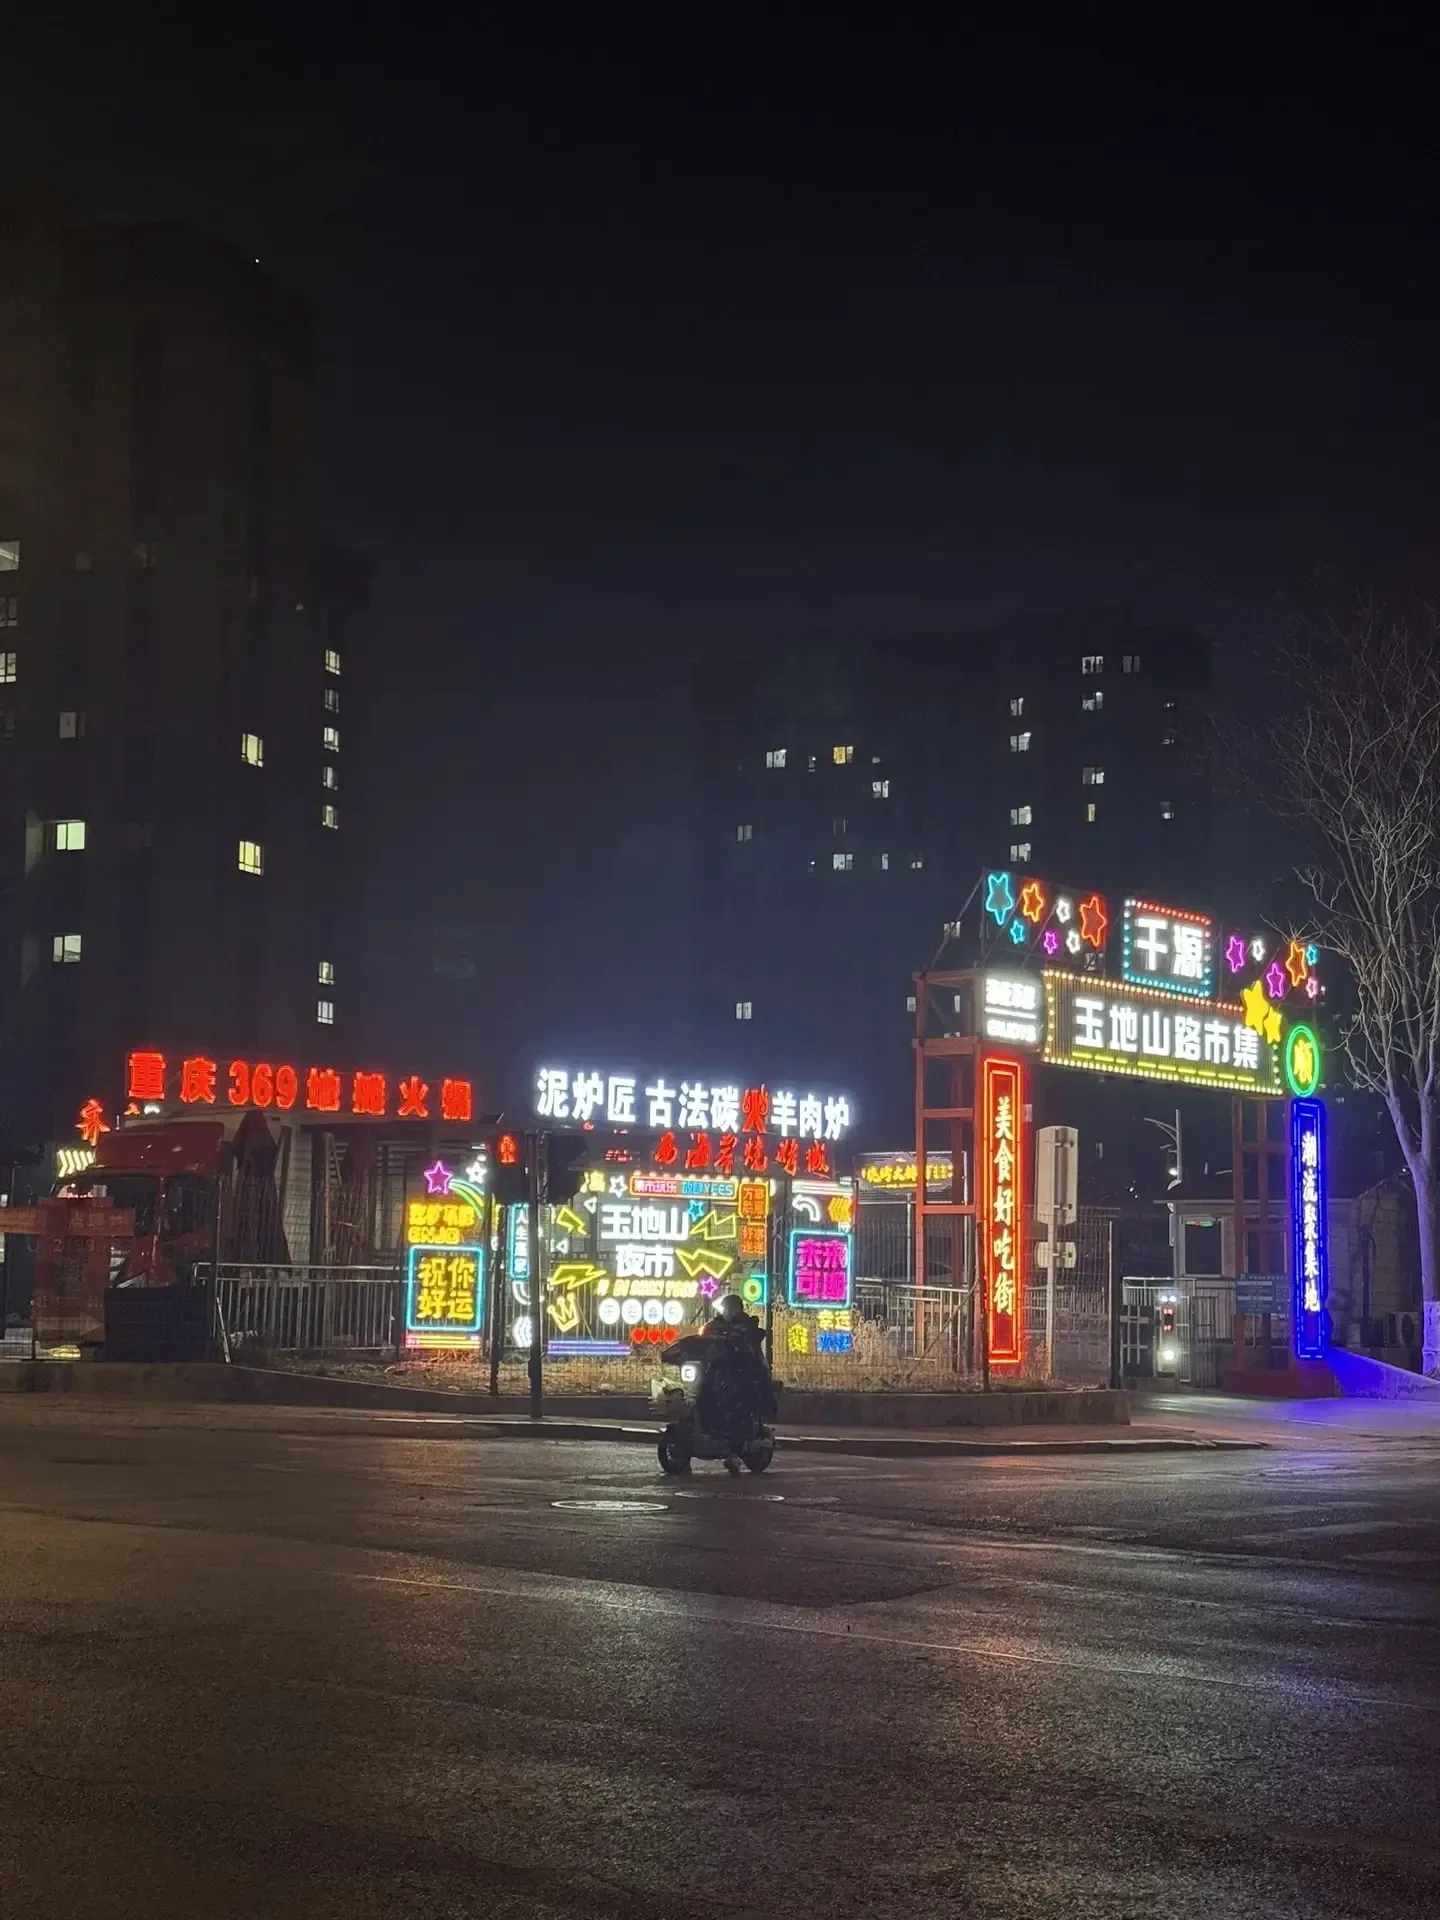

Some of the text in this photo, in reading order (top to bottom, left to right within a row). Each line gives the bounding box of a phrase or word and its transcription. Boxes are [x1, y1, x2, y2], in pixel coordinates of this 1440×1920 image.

[1074, 998, 1260, 1069] 玉地山路市集
[537, 1068, 850, 1141] 泥炉匠 古法碳火羊肉炉
[600, 1204, 689, 1241] 玉地山
[993, 1096, 1015, 1316] 美食好吃街
[417, 1256, 476, 1288] 祝你
[615, 1244, 674, 1277] 夜市
[416, 1288, 475, 1320] 好运
